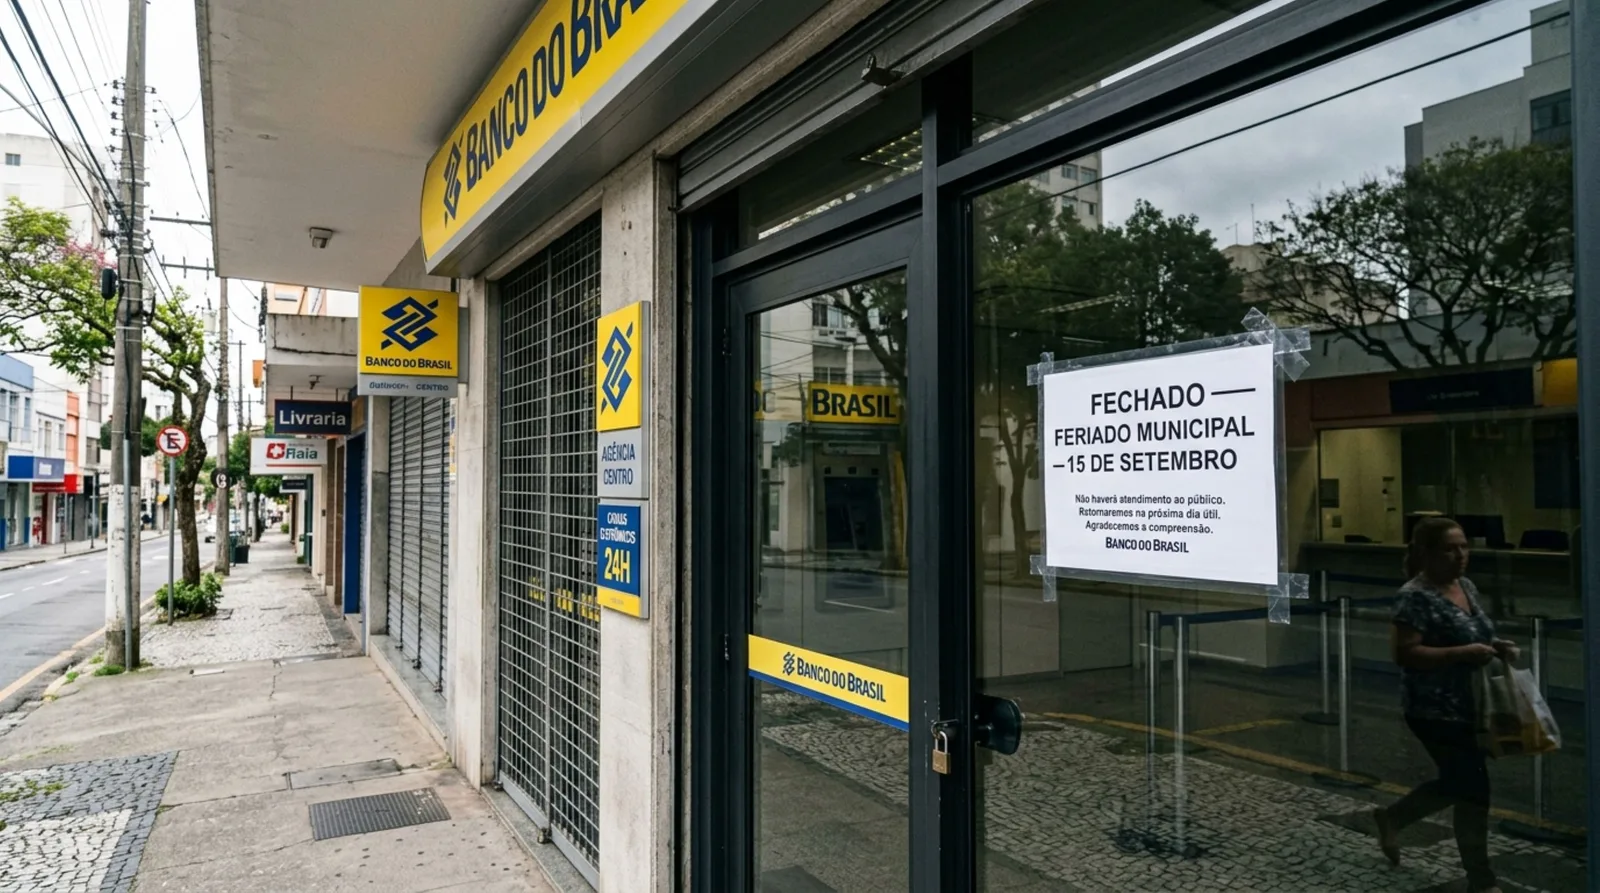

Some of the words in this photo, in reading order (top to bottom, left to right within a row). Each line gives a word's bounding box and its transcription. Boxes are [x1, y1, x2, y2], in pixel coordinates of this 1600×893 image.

[465, 66, 529, 193] BANCO
[532, 20, 566, 121] DO
[365, 356, 402, 368] BANCO
[403, 358, 417, 368] DO
[418, 358, 453, 370] BRASIL
[812, 388, 897, 419] BRASIL
[1090, 382, 1205, 416] FECHADO
[279, 409, 347, 426] Livraria
[1054, 423, 1132, 447] FERIADO
[1137, 415, 1256, 443] MUNICIPAL
[1090, 453, 1115, 473] DE
[1119, 448, 1239, 472] SETEMBRO
[1119, 494, 1172, 505] atendimento
[1174, 496, 1185, 505] ao
[1135, 510, 1146, 518] na
[1186, 508, 1201, 519] dia
[1105, 536, 1138, 551] BANCO
[1153, 538, 1190, 554] BRASIL
[603, 546, 631, 584] 24H
[797, 656, 831, 685] BANCO
[847, 671, 887, 703] BRASIL
